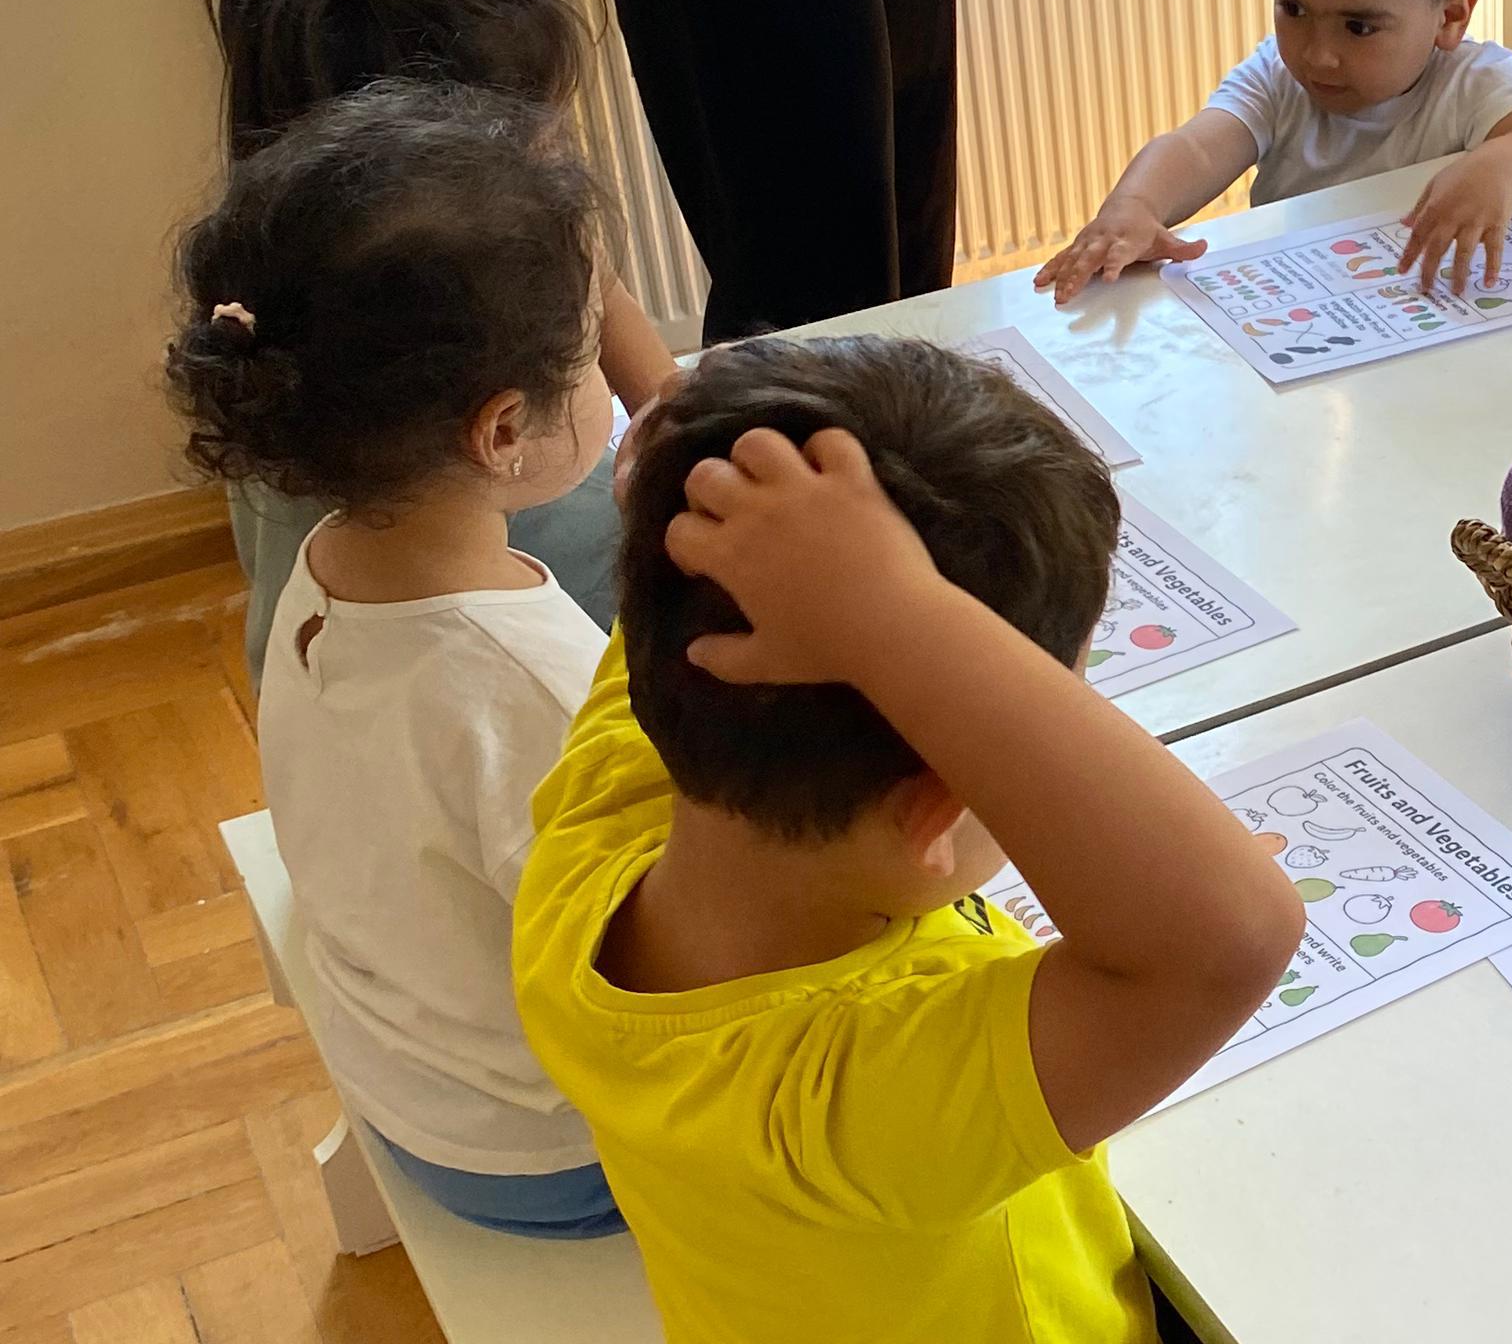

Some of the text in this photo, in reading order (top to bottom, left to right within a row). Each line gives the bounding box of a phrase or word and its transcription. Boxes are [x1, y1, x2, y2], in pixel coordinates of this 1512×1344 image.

[1127, 577, 1169, 611] vegetables
[1128, 547, 1164, 568] and
[1154, 565, 1232, 626] Vegetables
[1344, 758, 1397, 800] Fruits
[1391, 798, 1435, 826] and
[1313, 771, 1449, 882] Color the fruits and vegetables
[1317, 945, 1347, 972] write
